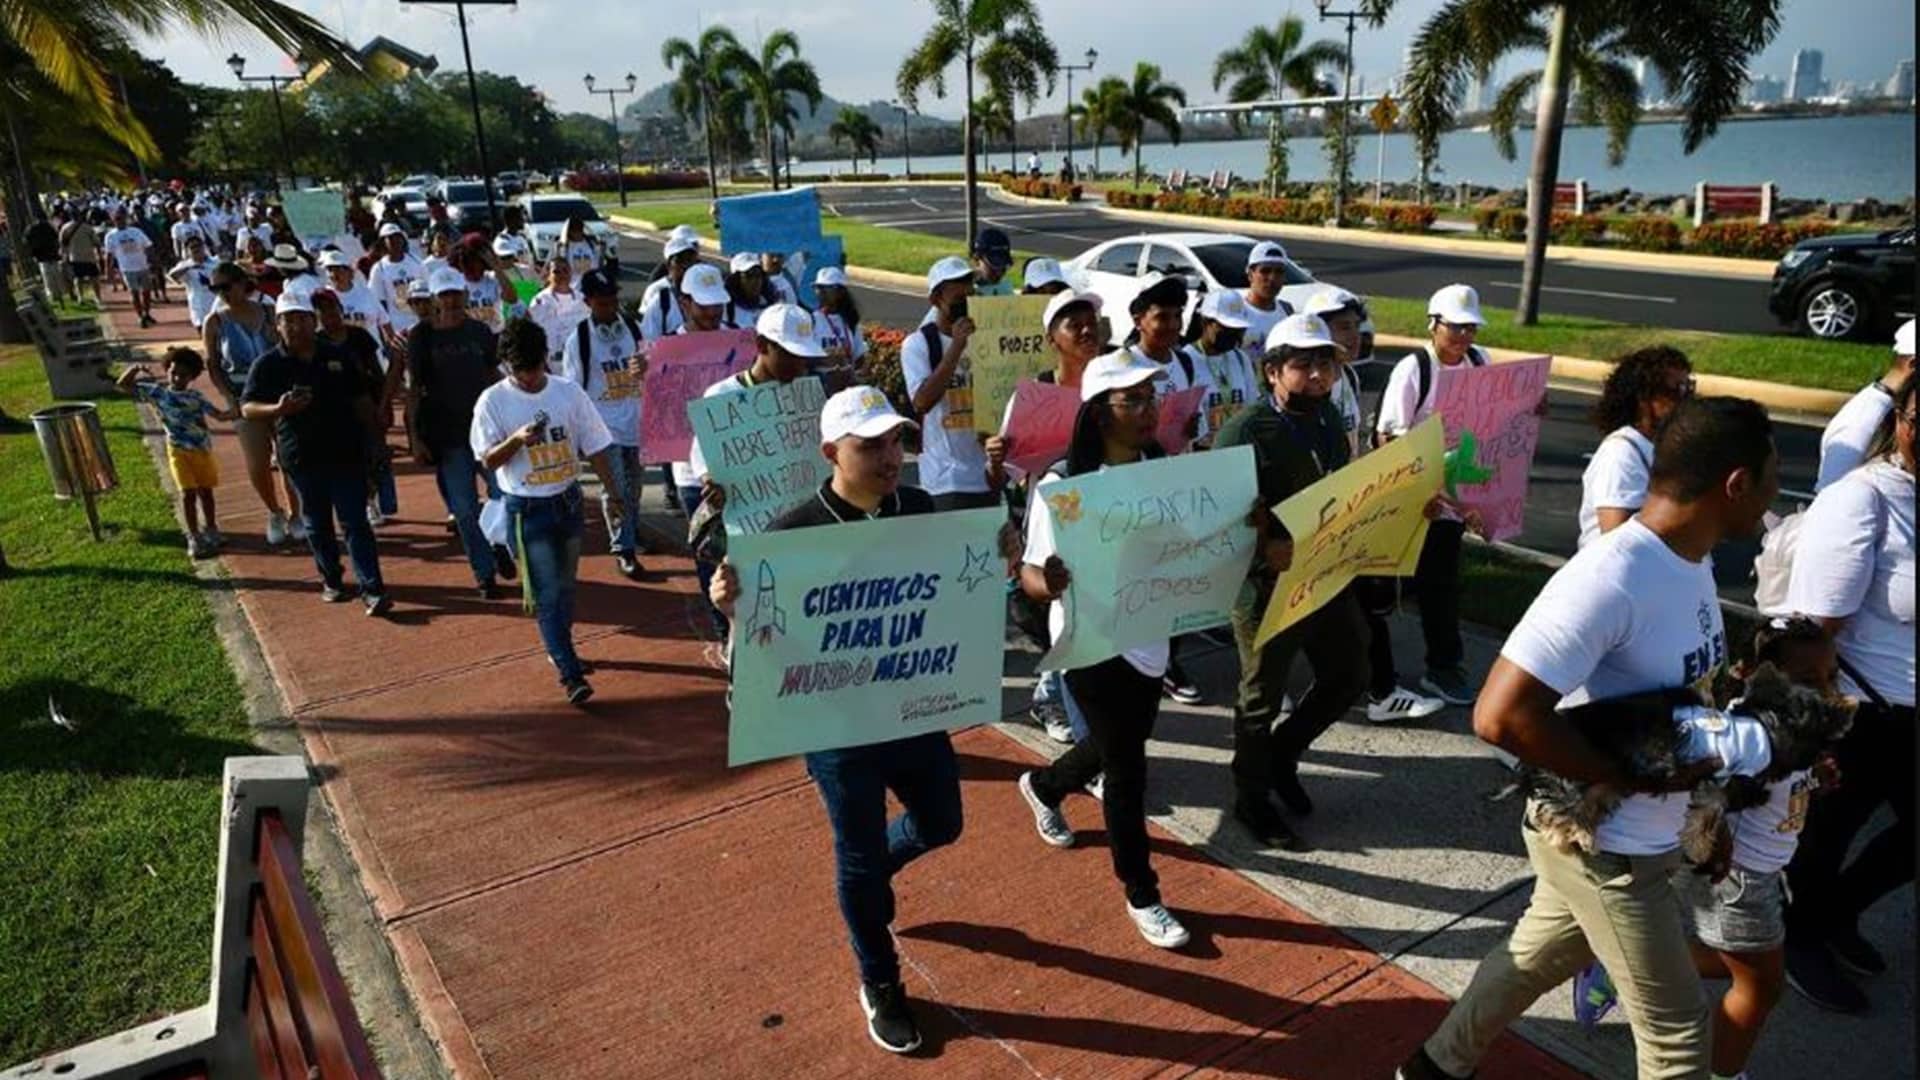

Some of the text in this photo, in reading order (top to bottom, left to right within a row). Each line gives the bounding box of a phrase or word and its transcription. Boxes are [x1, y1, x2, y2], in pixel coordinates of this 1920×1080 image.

[998, 334, 1044, 357] PODER
[706, 402, 745, 433] LA
[721, 428, 777, 468] ABRE
[731, 483, 749, 510] A
[746, 472, 781, 502] UN
[1100, 486, 1219, 544] CIENCIA
[1112, 576, 1212, 631] TODOS
[820, 608, 927, 653] PARA UN
[778, 642, 959, 697] MUNDO MEJOR!
[1683, 641, 1711, 685] EN
